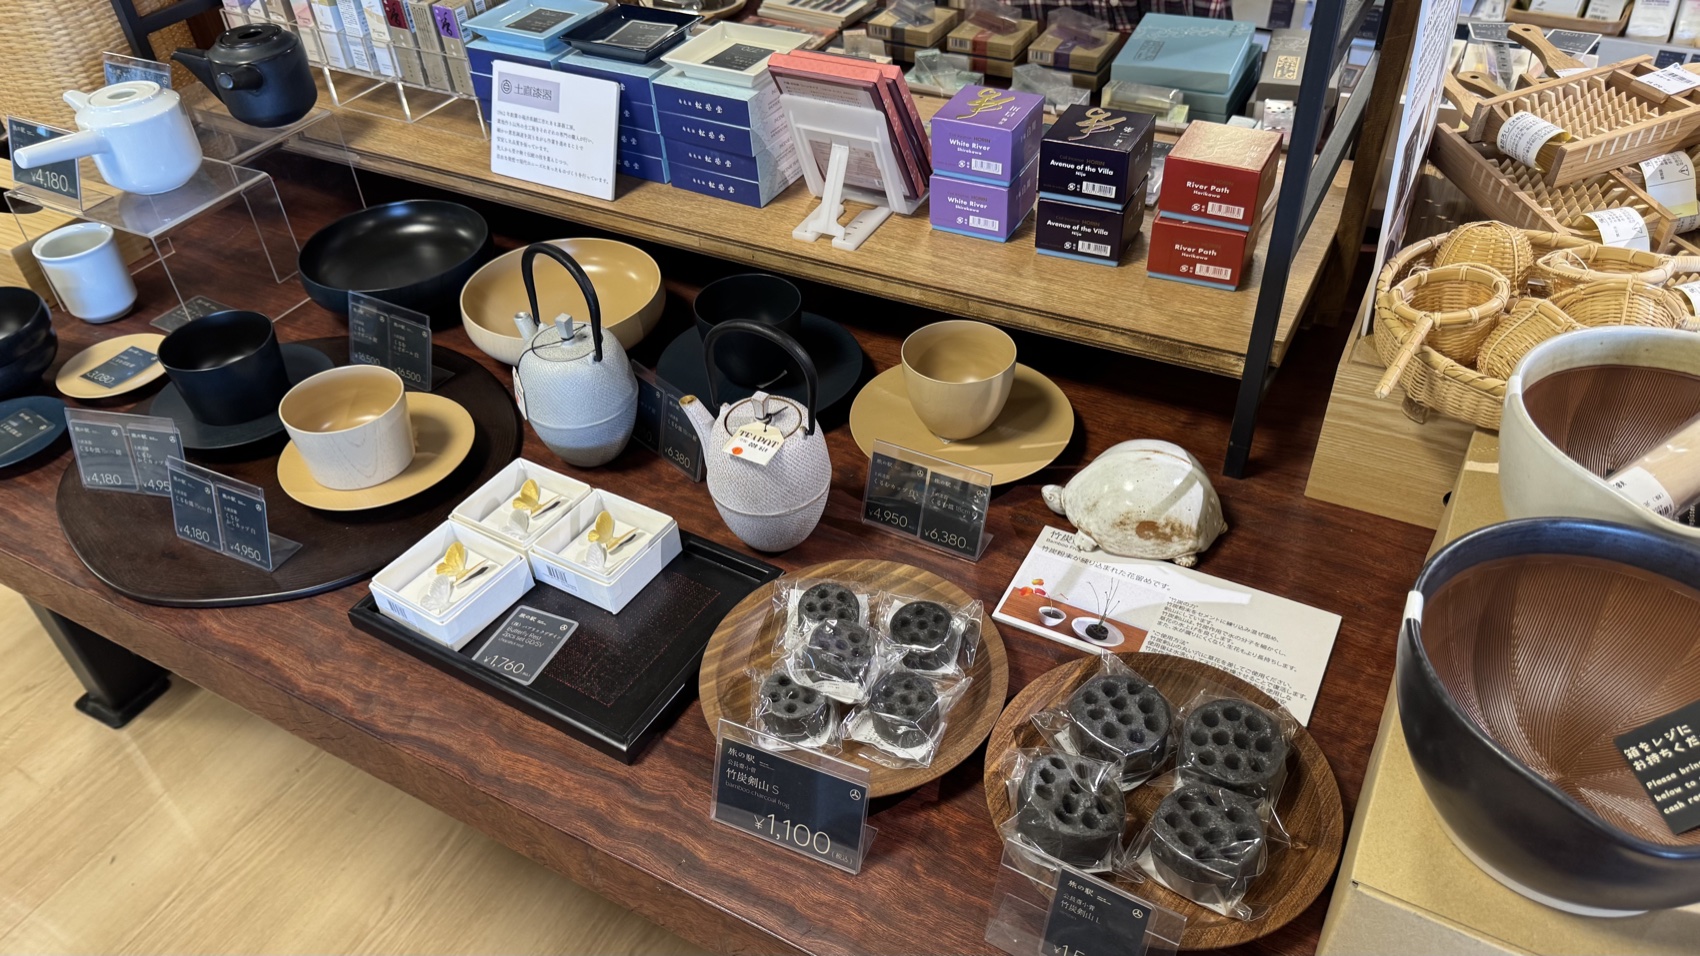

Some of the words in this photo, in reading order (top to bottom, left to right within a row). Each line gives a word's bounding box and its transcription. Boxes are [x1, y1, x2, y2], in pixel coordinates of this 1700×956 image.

[514, 84, 552, 101] 土直漆器
[949, 139, 970, 148] White
[972, 142, 991, 151] River
[1050, 159, 1075, 170] Avenue
[1085, 165, 1096, 173] the
[1097, 167, 1114, 176] Villa
[30, 168, 69, 192] ¥4,180
[1186, 181, 1208, 190] River
[1210, 185, 1230, 194] Path
[947, 196, 968, 205] White
[969, 201, 988, 209] River
[1046, 219, 1071, 229] Avenue
[1080, 225, 1092, 233] the
[1093, 227, 1109, 236] Villa
[1174, 243, 1196, 253] River
[1198, 247, 1217, 256] Path
[739, 429, 780, 448] TEAPOT
[664, 446, 691, 469] ¥6,380
[85, 472, 122, 485] ¥4,180
[143, 478, 172, 492] ¥4,95
[868, 507, 908, 528] ¥4,950
[178, 524, 210, 543] ¥4,180
[924, 528, 967, 549] ¥6,380
[1050, 530, 1076, 545] 竹炭
[230, 542, 261, 562] ¥4,950
[1041, 545, 1171, 591] 竹炭粉末が練り込まれた花留めです。
[506, 626, 528, 637] Butterfly
[528, 632, 542, 641] Rest
[483, 654, 525, 674] ¥1,760
[1624, 724, 1692, 759] 箱をレジに
[1633, 734, 1700, 771] お持ちくだ
[725, 767, 769, 792] 竹炭剣山
[771, 784, 780, 795] S
[1646, 772, 1677, 790] Please
[1679, 761, 1700, 775] brin
[725, 780, 750, 794] bamboo
[750, 791, 777, 804] charcoal
[1654, 786, 1682, 802] below
[1684, 780, 1697, 789] to
[1663, 800, 1686, 815] cash
[753, 813, 831, 855] ¥1,100
[1061, 900, 1094, 921] 竹炭剣山
[1095, 916, 1101, 925] L
